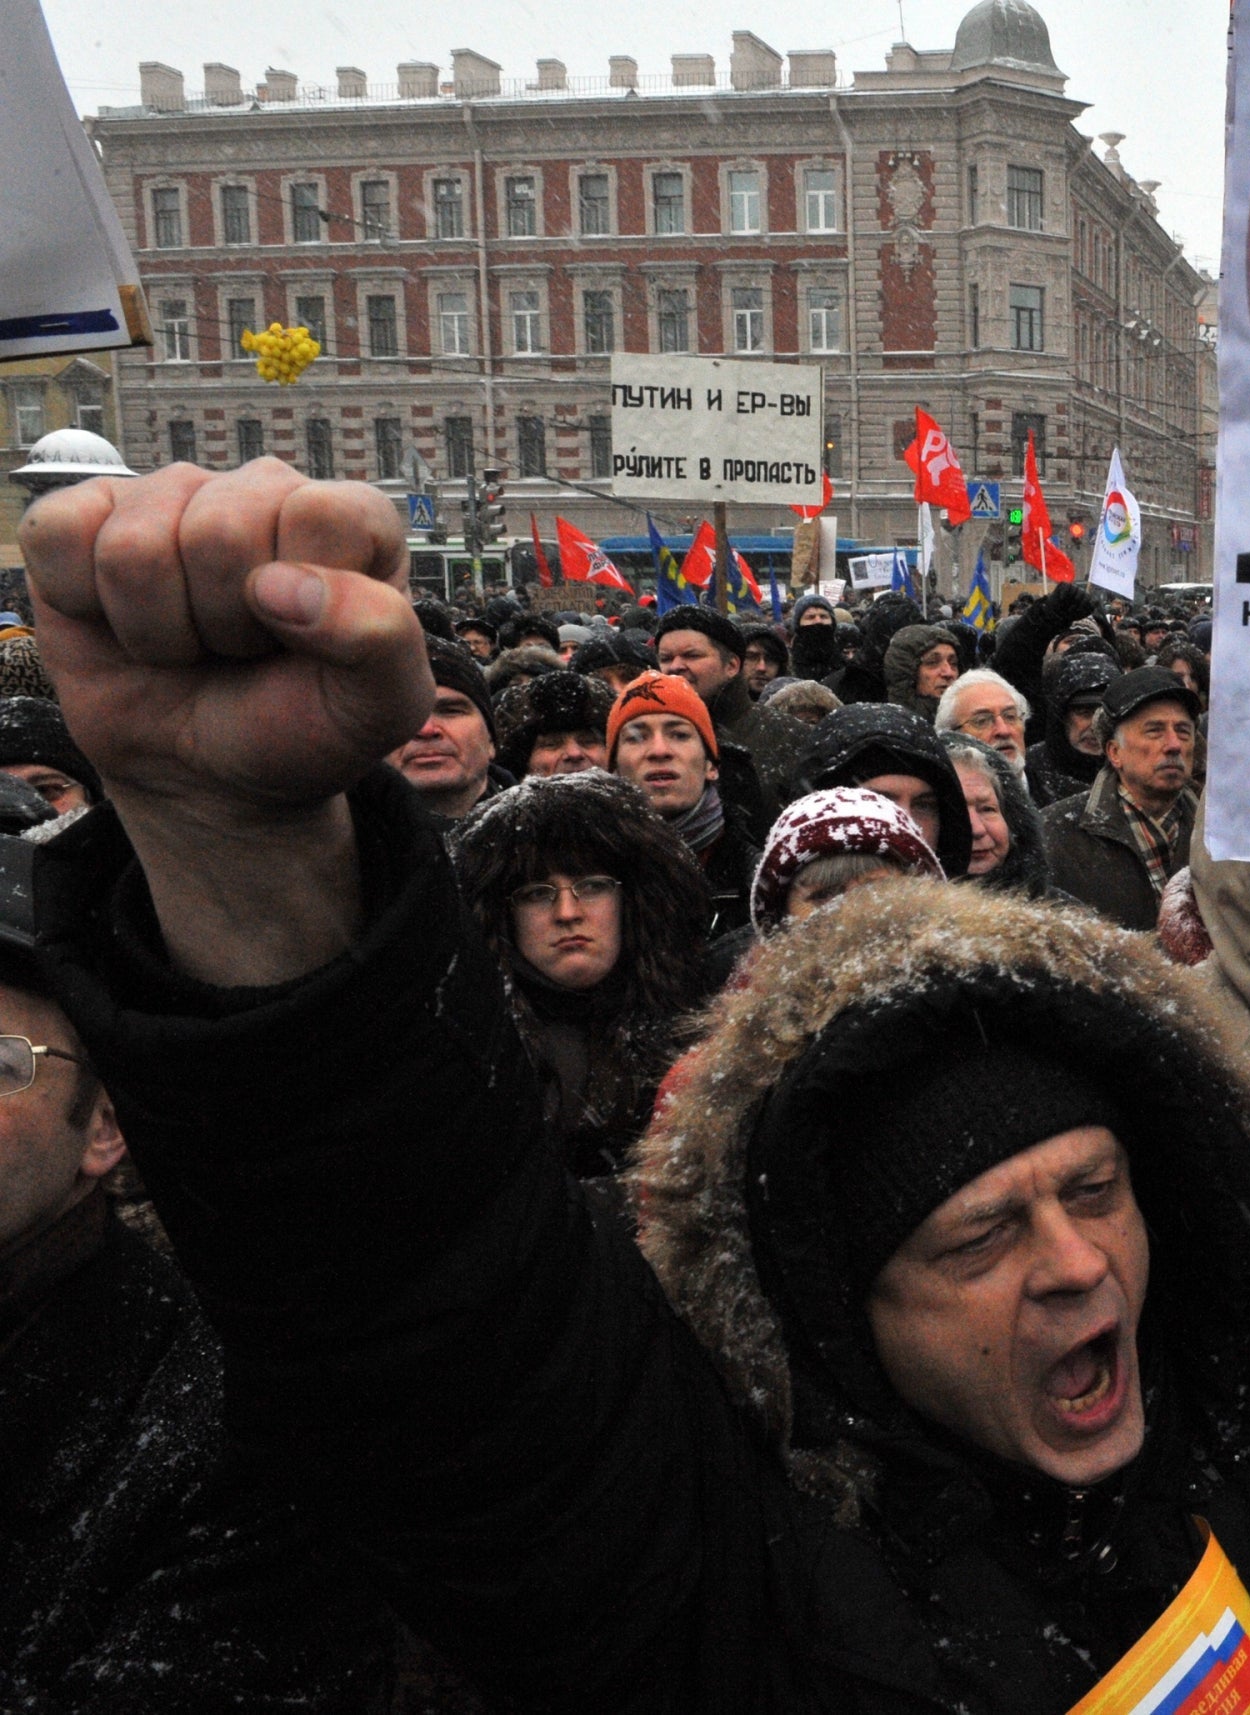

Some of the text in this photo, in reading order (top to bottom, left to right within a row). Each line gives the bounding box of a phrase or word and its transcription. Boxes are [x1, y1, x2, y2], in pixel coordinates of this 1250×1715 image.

[612, 385, 810, 416] ПУТИН И ЕР-ВЫ
[700, 457, 711, 480] В
[723, 459, 816, 484] ПРОПАСТЬ
